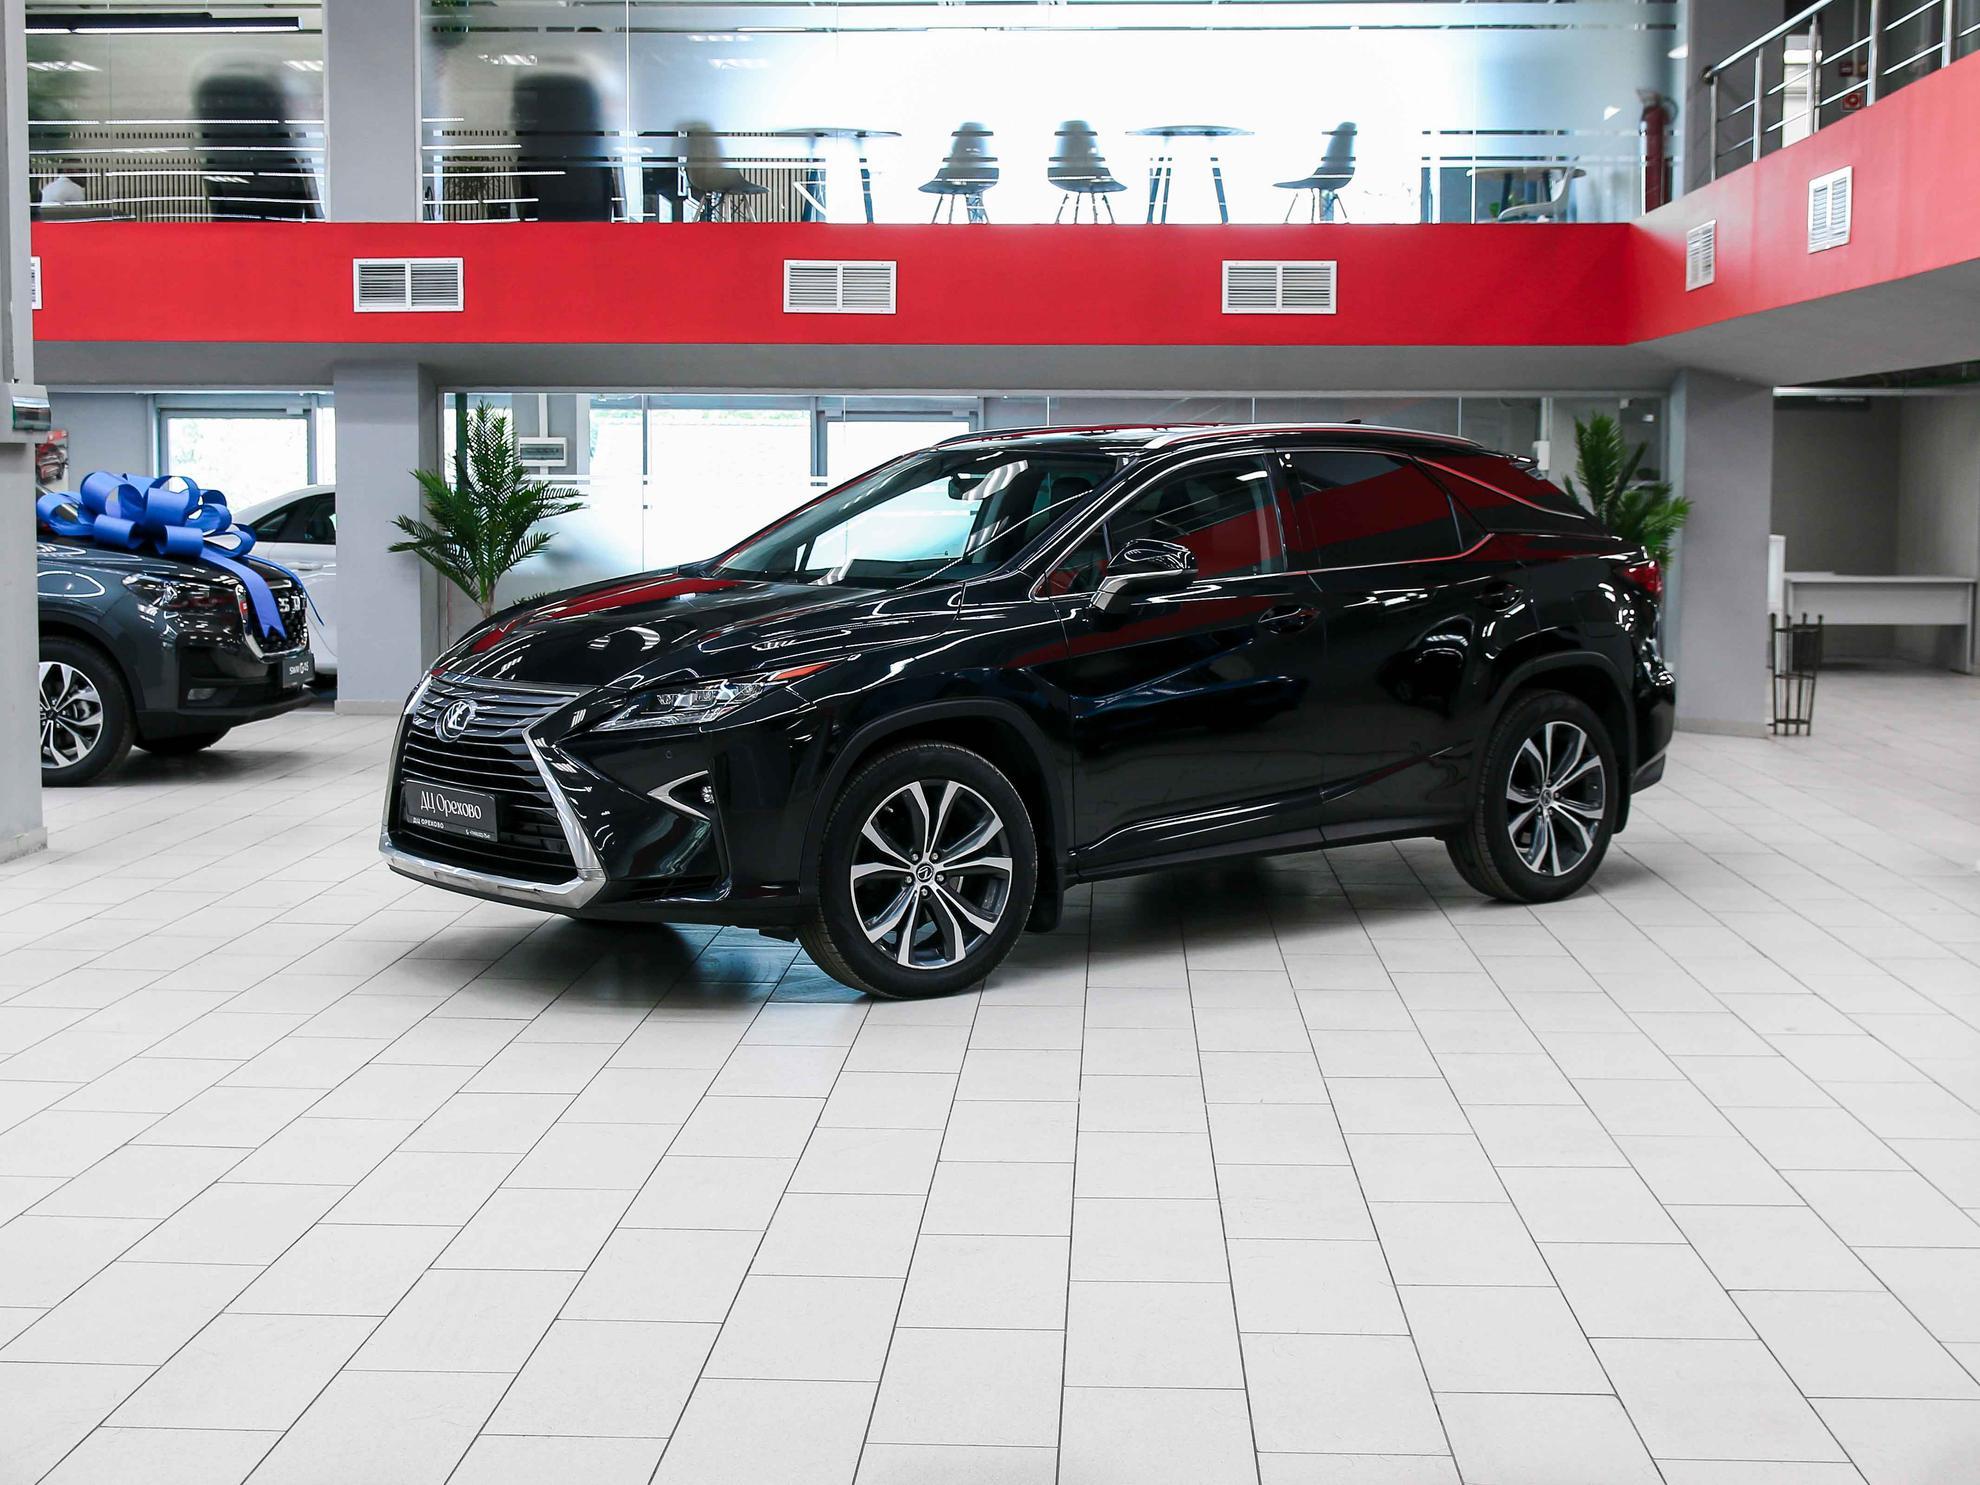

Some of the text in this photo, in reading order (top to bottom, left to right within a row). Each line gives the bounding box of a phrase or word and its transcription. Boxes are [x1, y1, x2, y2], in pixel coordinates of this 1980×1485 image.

[421, 790, 481, 819] ДЦ Орехово
[421, 818, 444, 829] ОРЕХОВО
